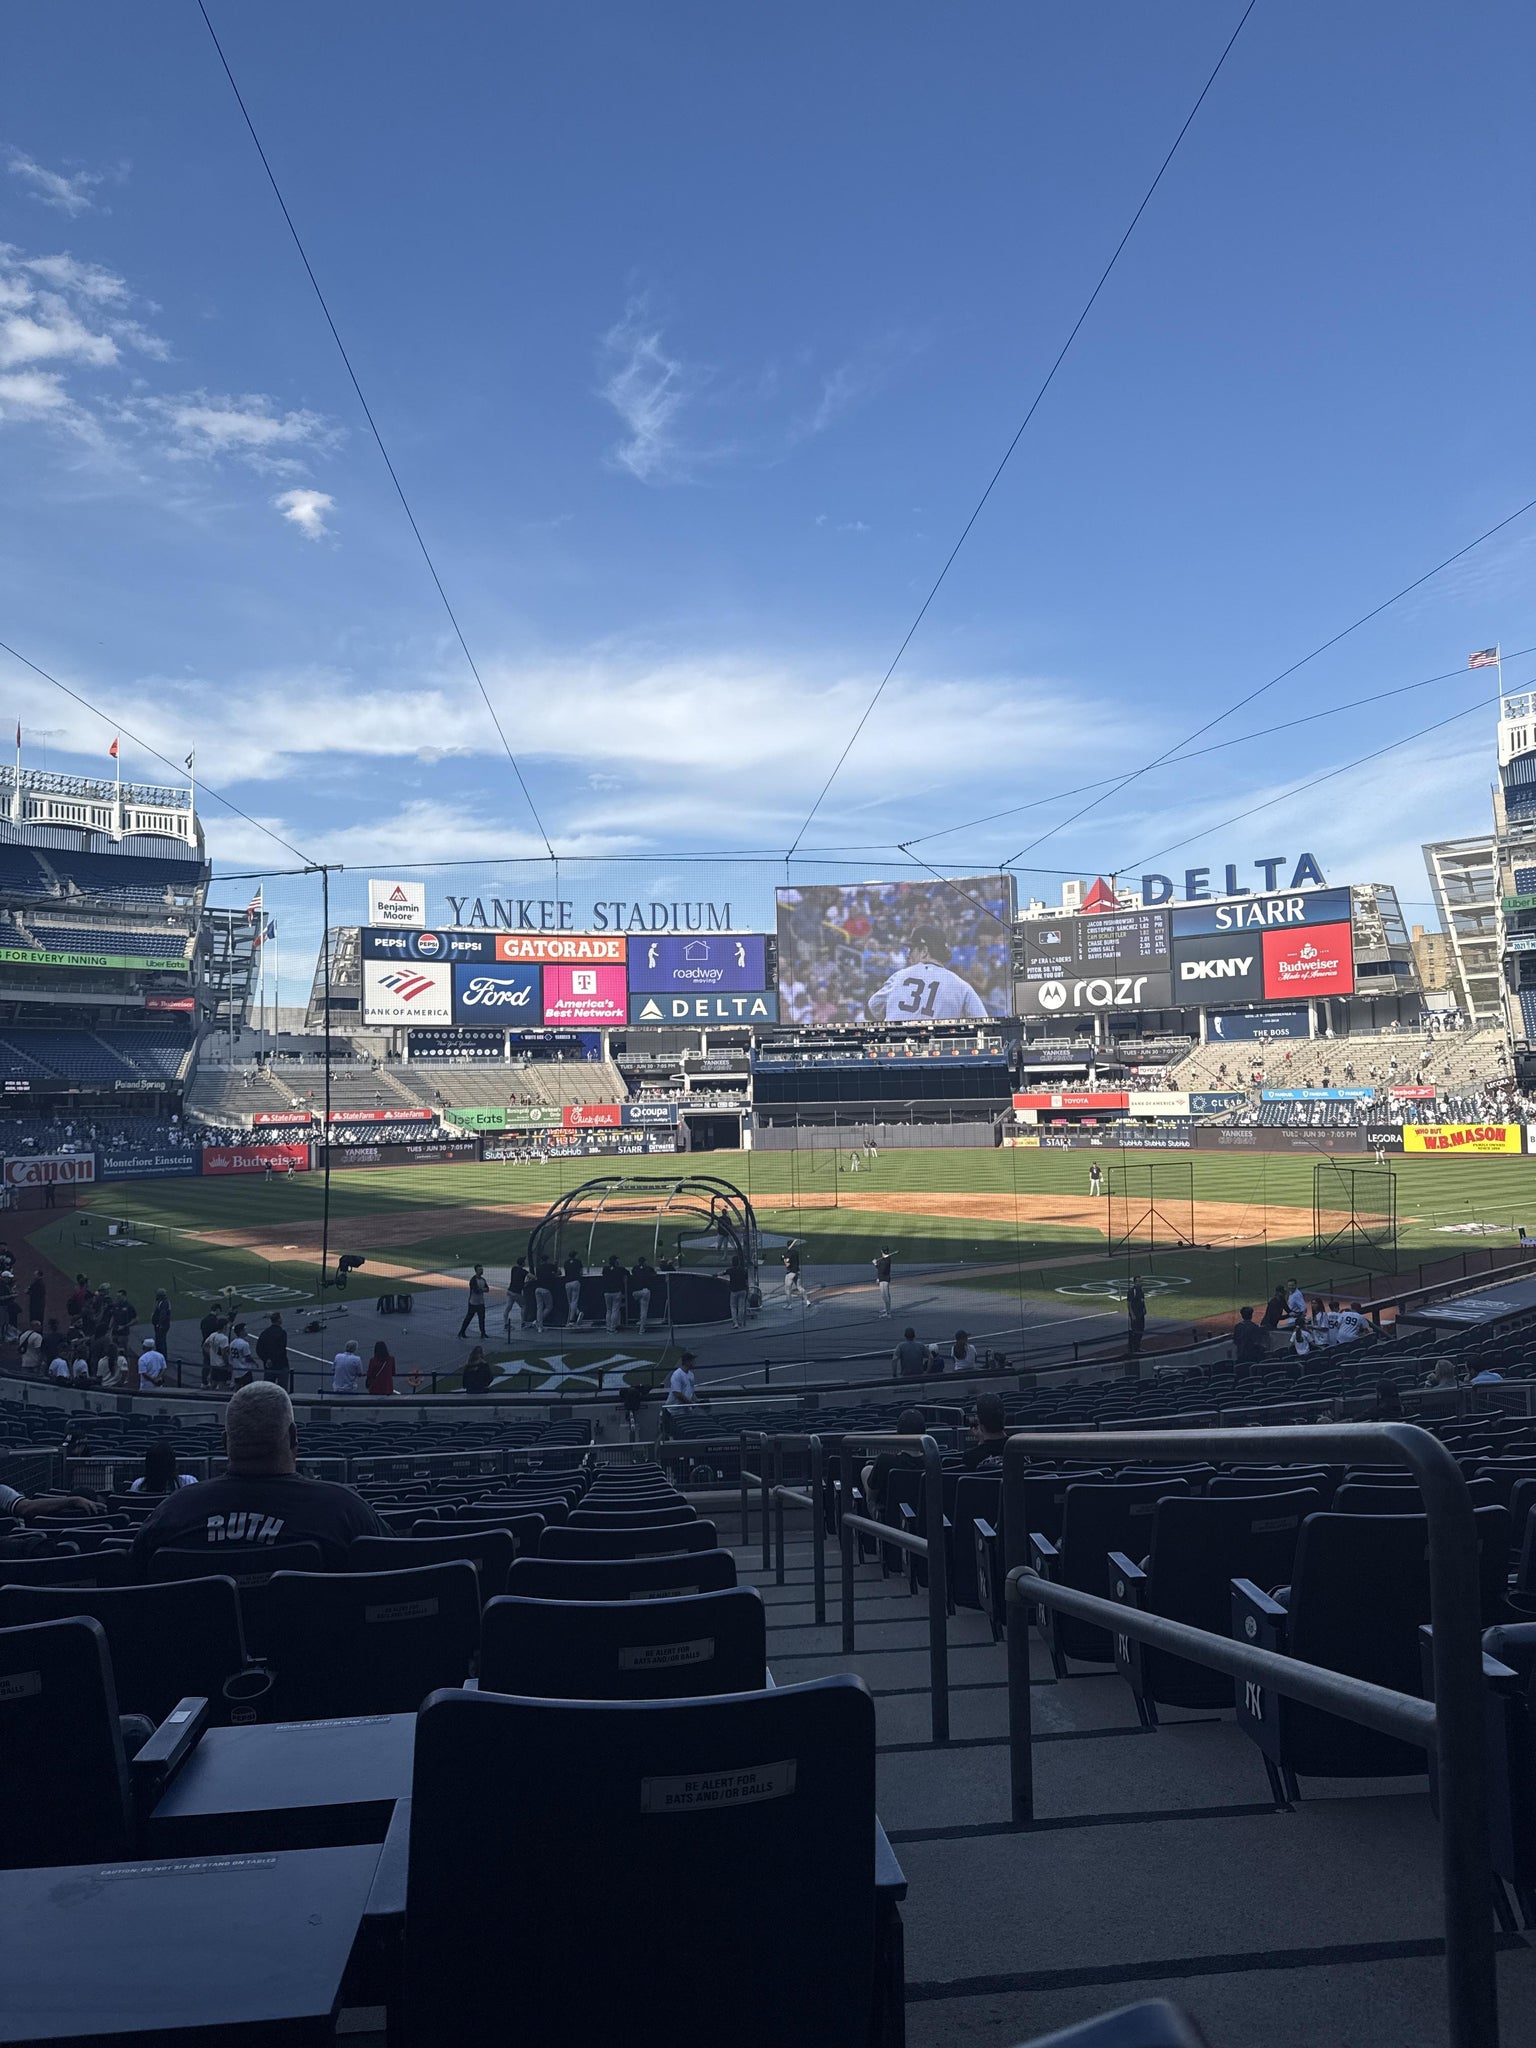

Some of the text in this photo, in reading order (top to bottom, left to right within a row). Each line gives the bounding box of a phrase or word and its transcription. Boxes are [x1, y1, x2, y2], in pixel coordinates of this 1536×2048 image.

[1142, 853, 1326, 906] DELTA
[378, 902, 419, 912] Benjamin
[445, 896, 733, 931] YANKEE STADIUM
[384, 912, 412, 920] Moore
[1216, 898, 1306, 930] STARR
[374, 938, 406, 948] PEPSI
[451, 942, 482, 950] PEPSI
[504, 940, 620, 958] GATORADE
[6, 952, 107, 966] FOR EVERY INNING
[166, 960, 186, 968] Eats
[1180, 956, 1254, 980] DKNY
[1278, 959, 1338, 973] Budweiser
[672, 967, 724, 980] roadway
[462, 978, 532, 1006] Ford
[898, 976, 940, 1018] 31
[1074, 976, 1148, 1006] razr
[160, 1000, 194, 1008] Budweiser
[554, 1000, 614, 1008] America's
[672, 998, 768, 1017] DELTA
[545, 1008, 624, 1018] Best Network
[115, 1080, 166, 1090] Poland Spring
[476, 1114, 502, 1124] Eats
[642, 1108, 668, 1117] coupa
[1368, 1134, 1402, 1142] LEGORA
[345, 1148, 378, 1156] YANKEES
[550, 1147, 582, 1156] StubHub
[618, 1146, 642, 1154] STARR
[104, 1154, 193, 1168] Montefiore Einstein
[232, 1155, 302, 1168] Budweiser
[6, 1160, 93, 1184] Canon
[1346, 1316, 1358, 1326] 99
[207, 1512, 285, 1545] RUTH
[656, 1648, 676, 1656] ALERT
[681, 1652, 700, 1660] BALLS
[685, 1774, 756, 1792] BE ALERT FOR
[666, 1782, 774, 1805] BATS AND/OR BALLS
